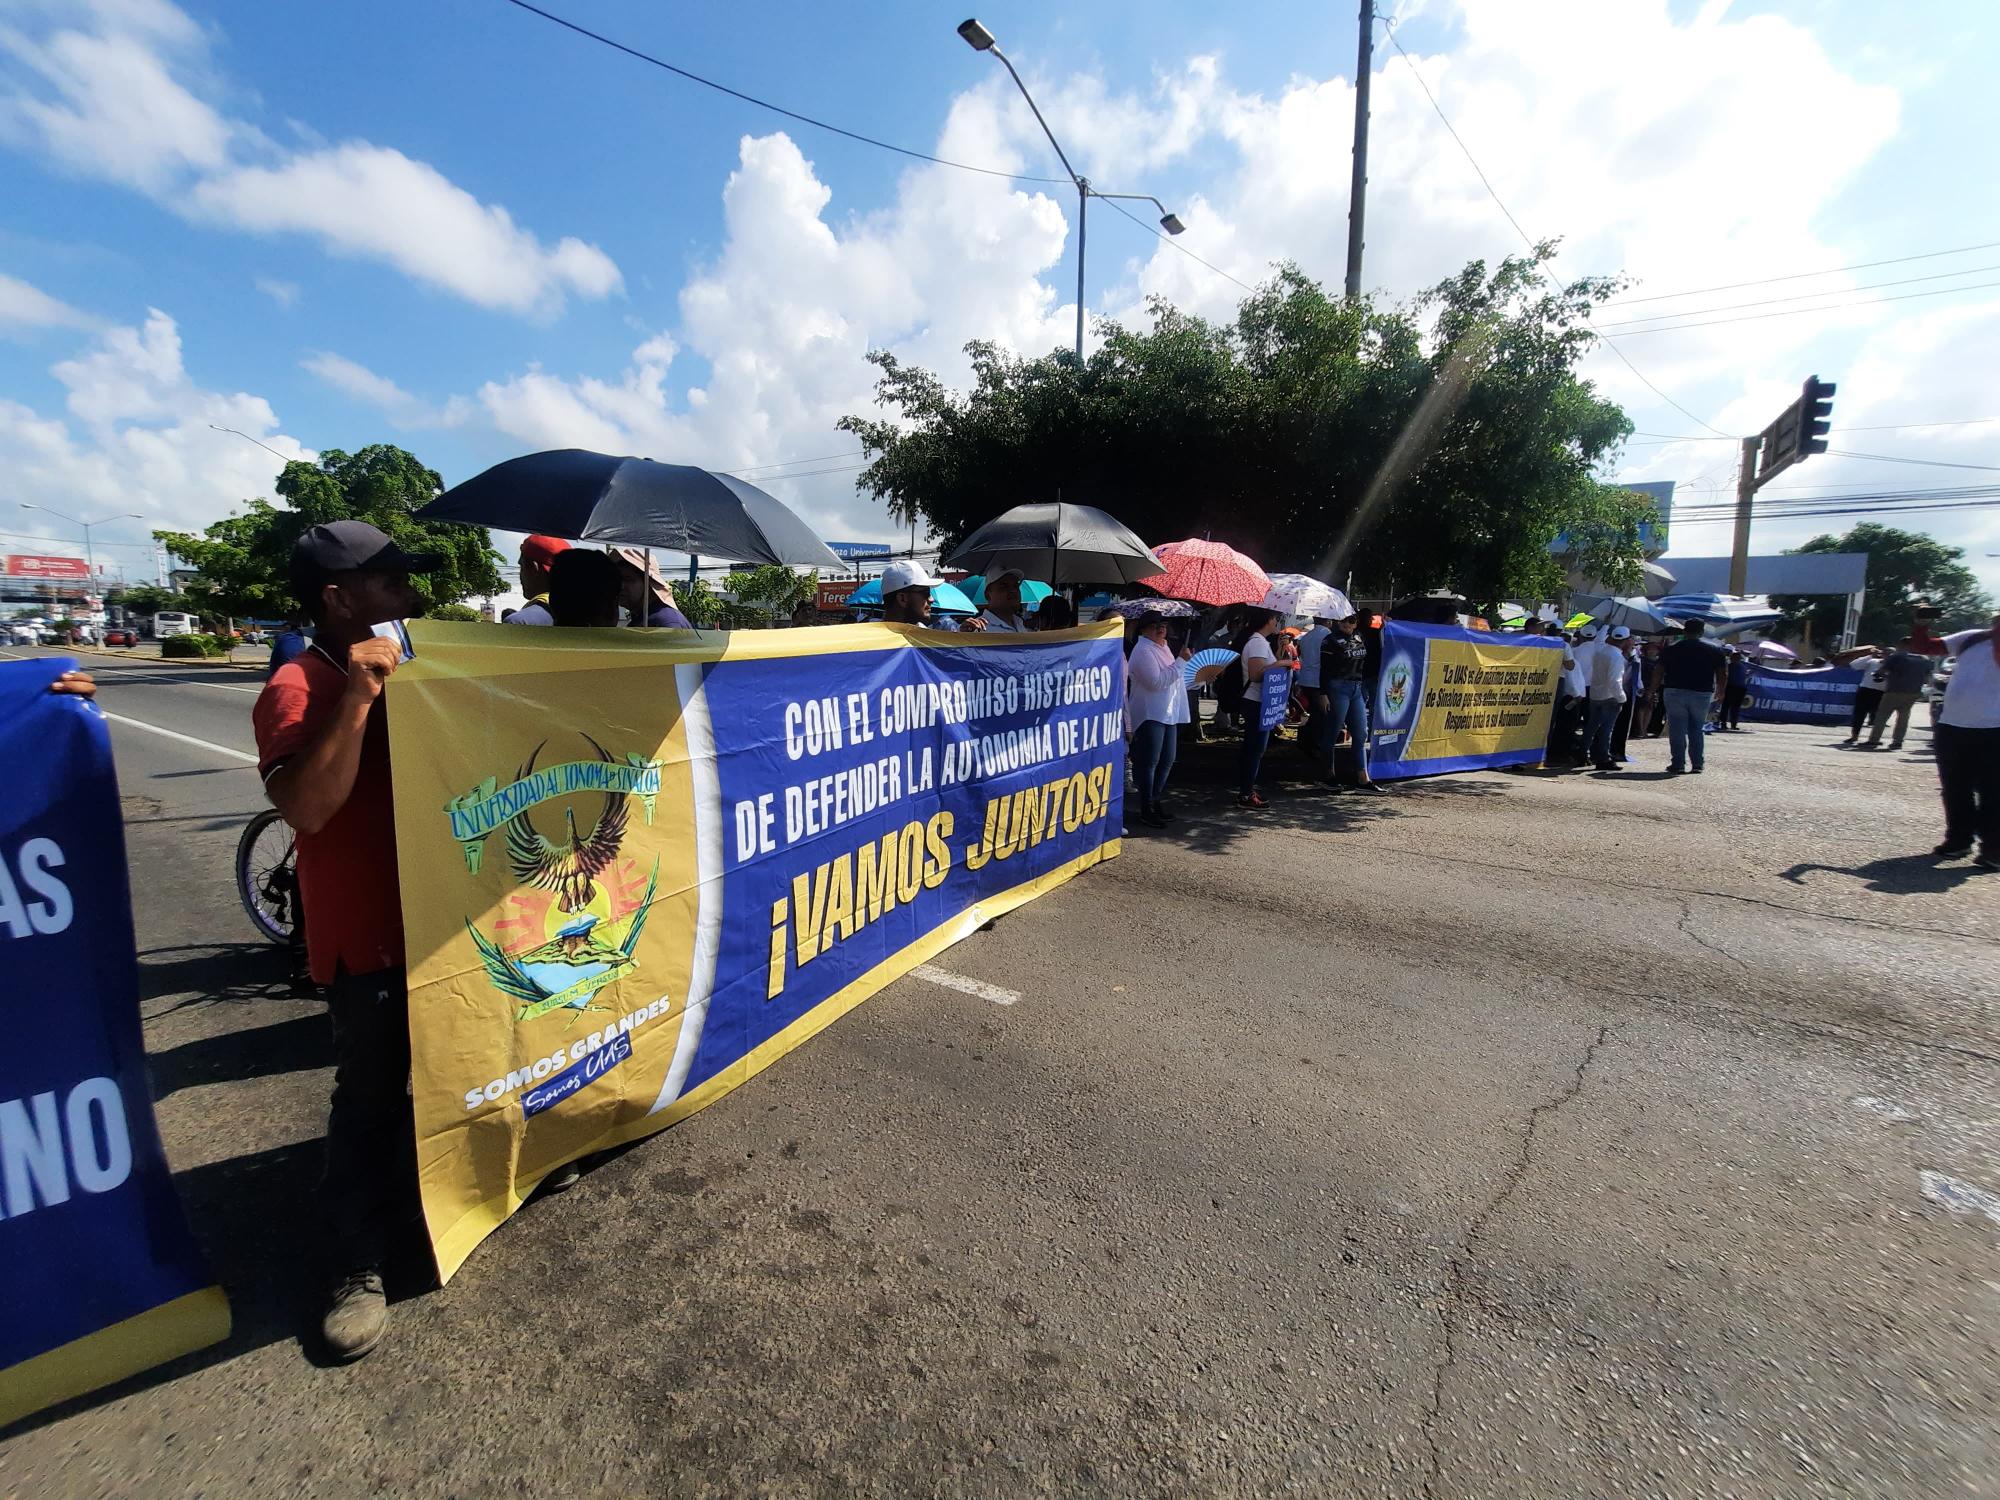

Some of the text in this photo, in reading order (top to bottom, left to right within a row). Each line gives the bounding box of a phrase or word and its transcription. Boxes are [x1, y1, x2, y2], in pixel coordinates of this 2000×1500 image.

[1268, 674, 1281, 683] POR
[1426, 687, 1436, 707] de
[1436, 687, 1463, 708] Sinaloa
[1454, 664, 1468, 685] UAS
[1519, 668, 1528, 685] de
[785, 662, 1111, 761] CON EL COMPROMISO HISTÓRICO
[1444, 710, 1472, 733] Respeto
[1486, 714, 1491, 728] a
[1490, 714, 1499, 728] su
[450, 773, 545, 838] UNIVERSIDAD
[735, 792, 775, 862] DE
[785, 755, 901, 843] DEFENDER
[907, 747, 933, 795] LA
[940, 717, 1053, 787] AUTONOMÍA
[1058, 719, 1079, 757] DE
[1083, 715, 1099, 751] LA
[767, 762, 1113, 999] ¡VAMOS JUNTOS!
[464, 994, 671, 1110] SOMOS GRANDES
[525, 1036, 629, 1114] Somos UAS
